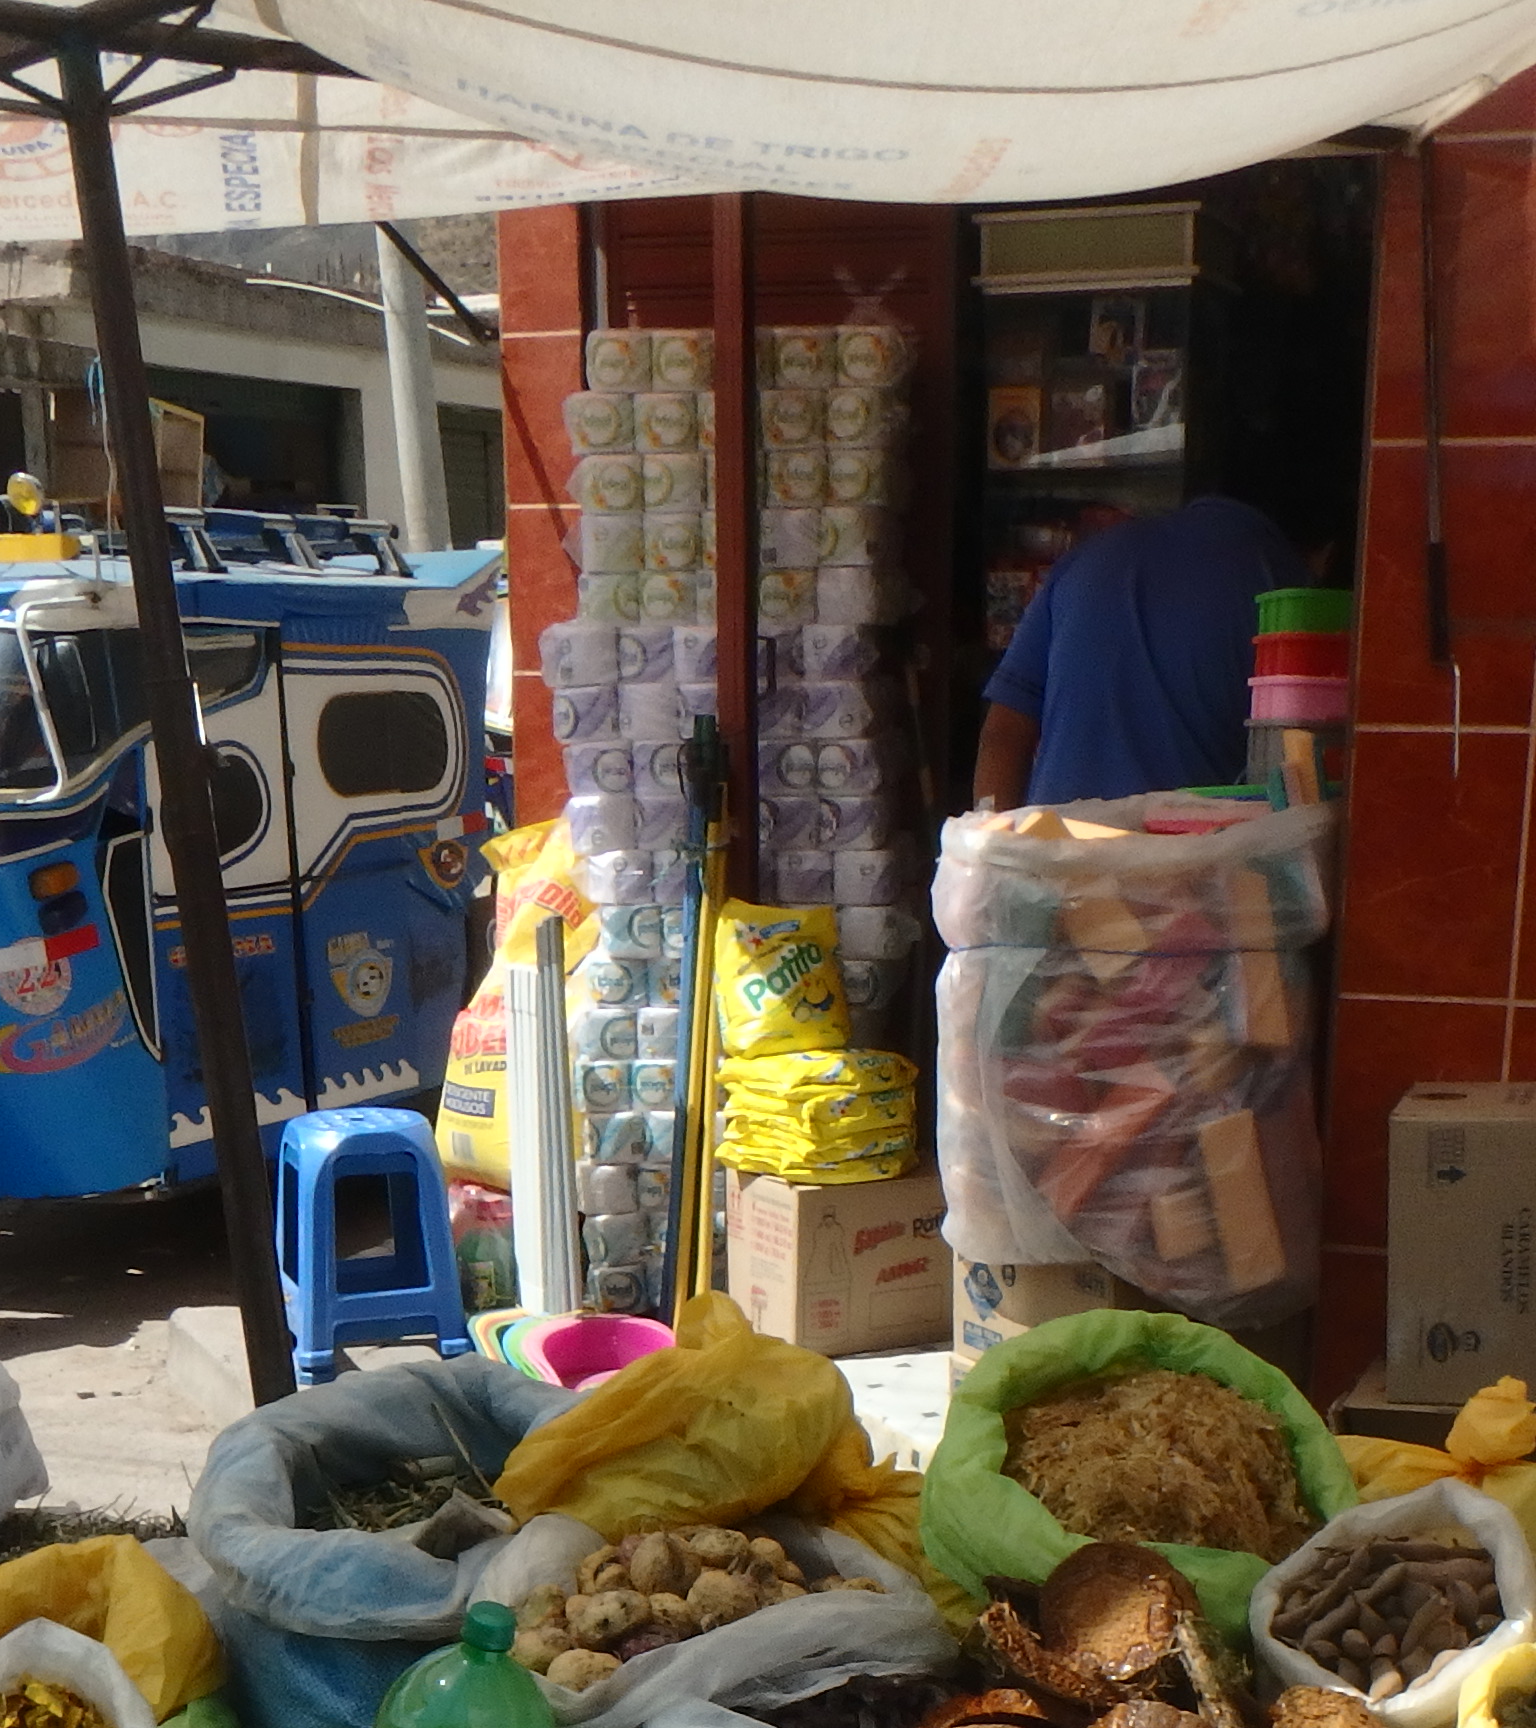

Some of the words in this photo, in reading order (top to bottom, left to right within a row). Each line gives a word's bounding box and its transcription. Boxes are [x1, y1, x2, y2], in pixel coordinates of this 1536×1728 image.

[219, 131, 262, 213] ESPECIA
[754, 140, 911, 161] TRIGO
[742, 942, 825, 1013] Patito
[475, 1060, 507, 1074] LAVAD
[1500, 1222, 1514, 1303] BLANDOS
[1517, 1207, 1532, 1315] CARAMELOS
